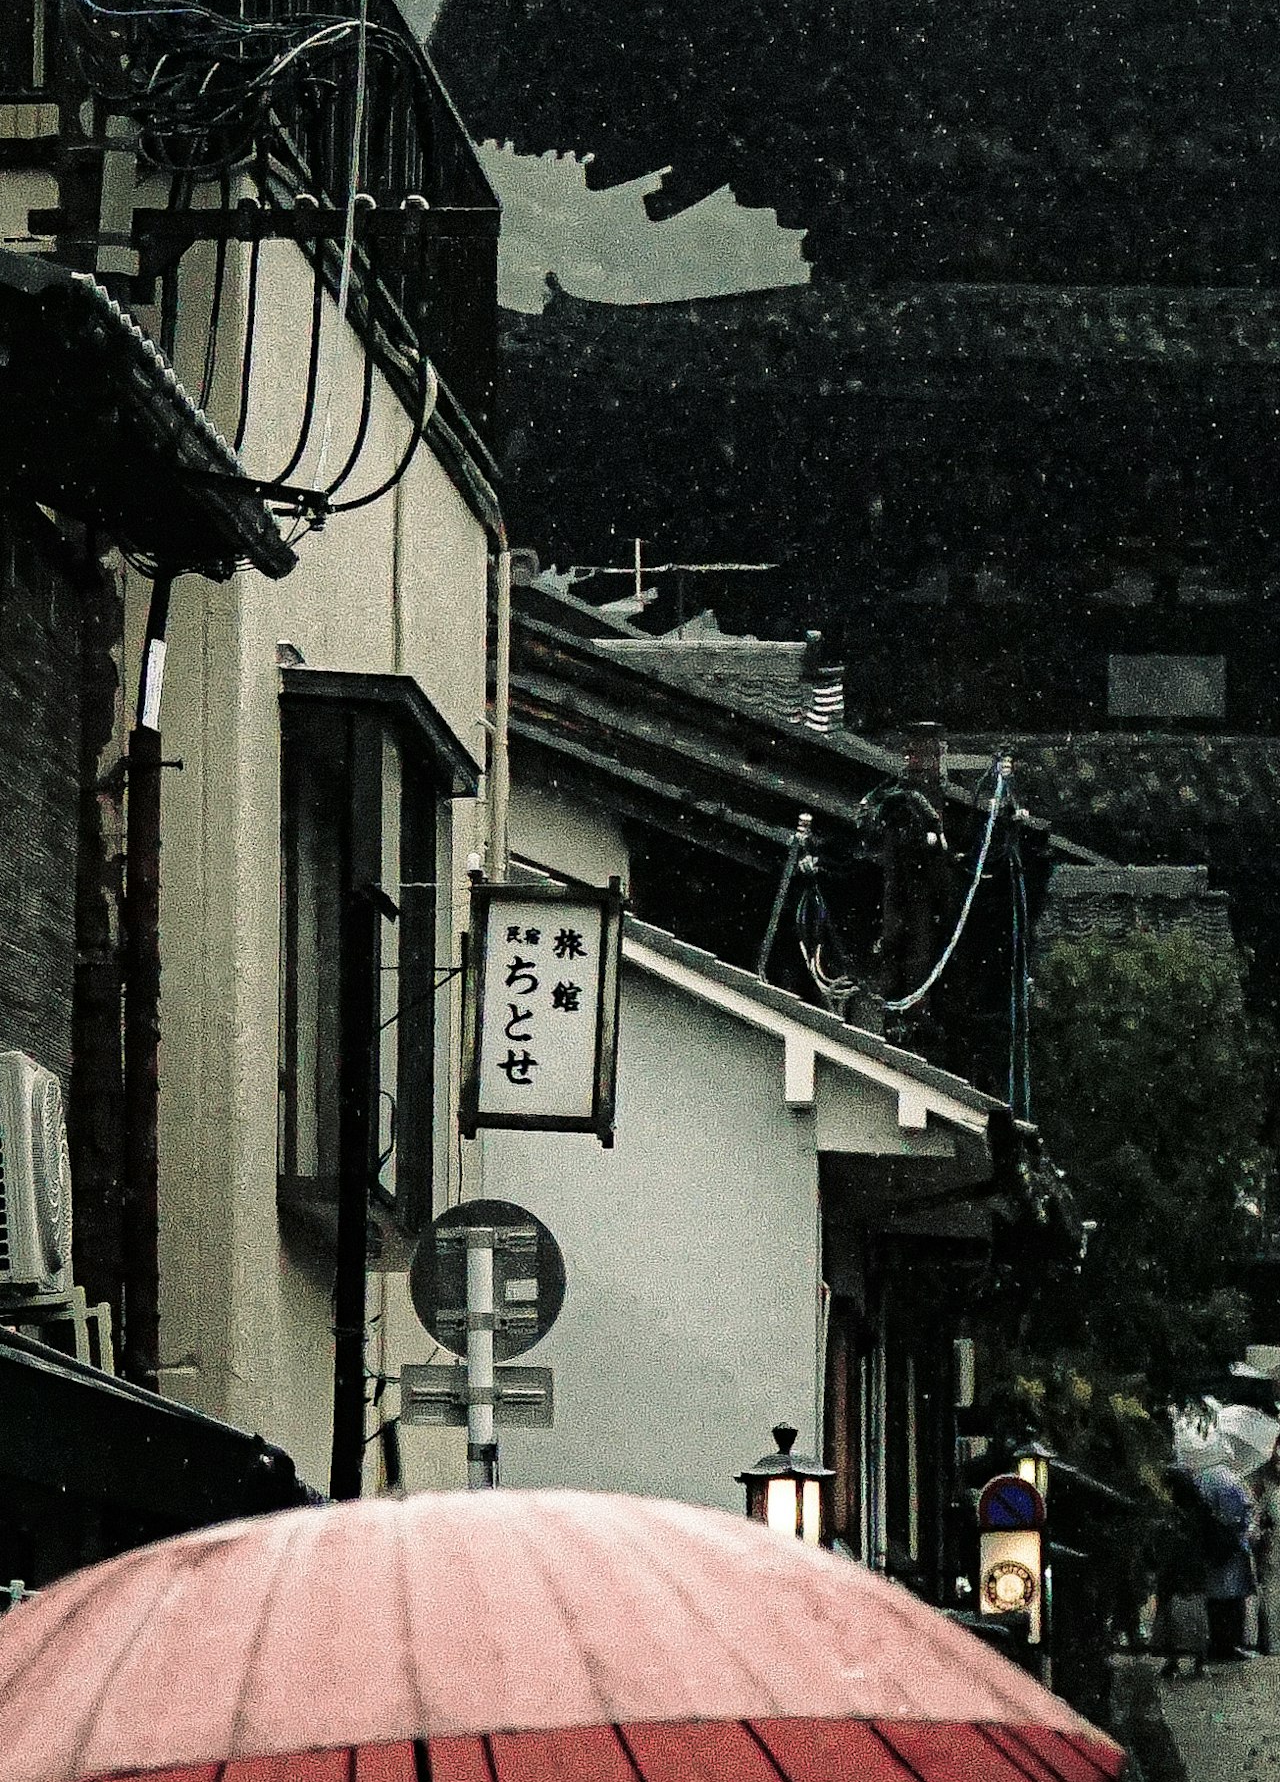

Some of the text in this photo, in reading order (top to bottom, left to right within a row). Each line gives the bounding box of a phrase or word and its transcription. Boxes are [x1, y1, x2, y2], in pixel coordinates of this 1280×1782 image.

[505, 925, 542, 946] 民宿
[550, 928, 588, 1013] 旅館
[496, 955, 540, 1085] ちとせ
